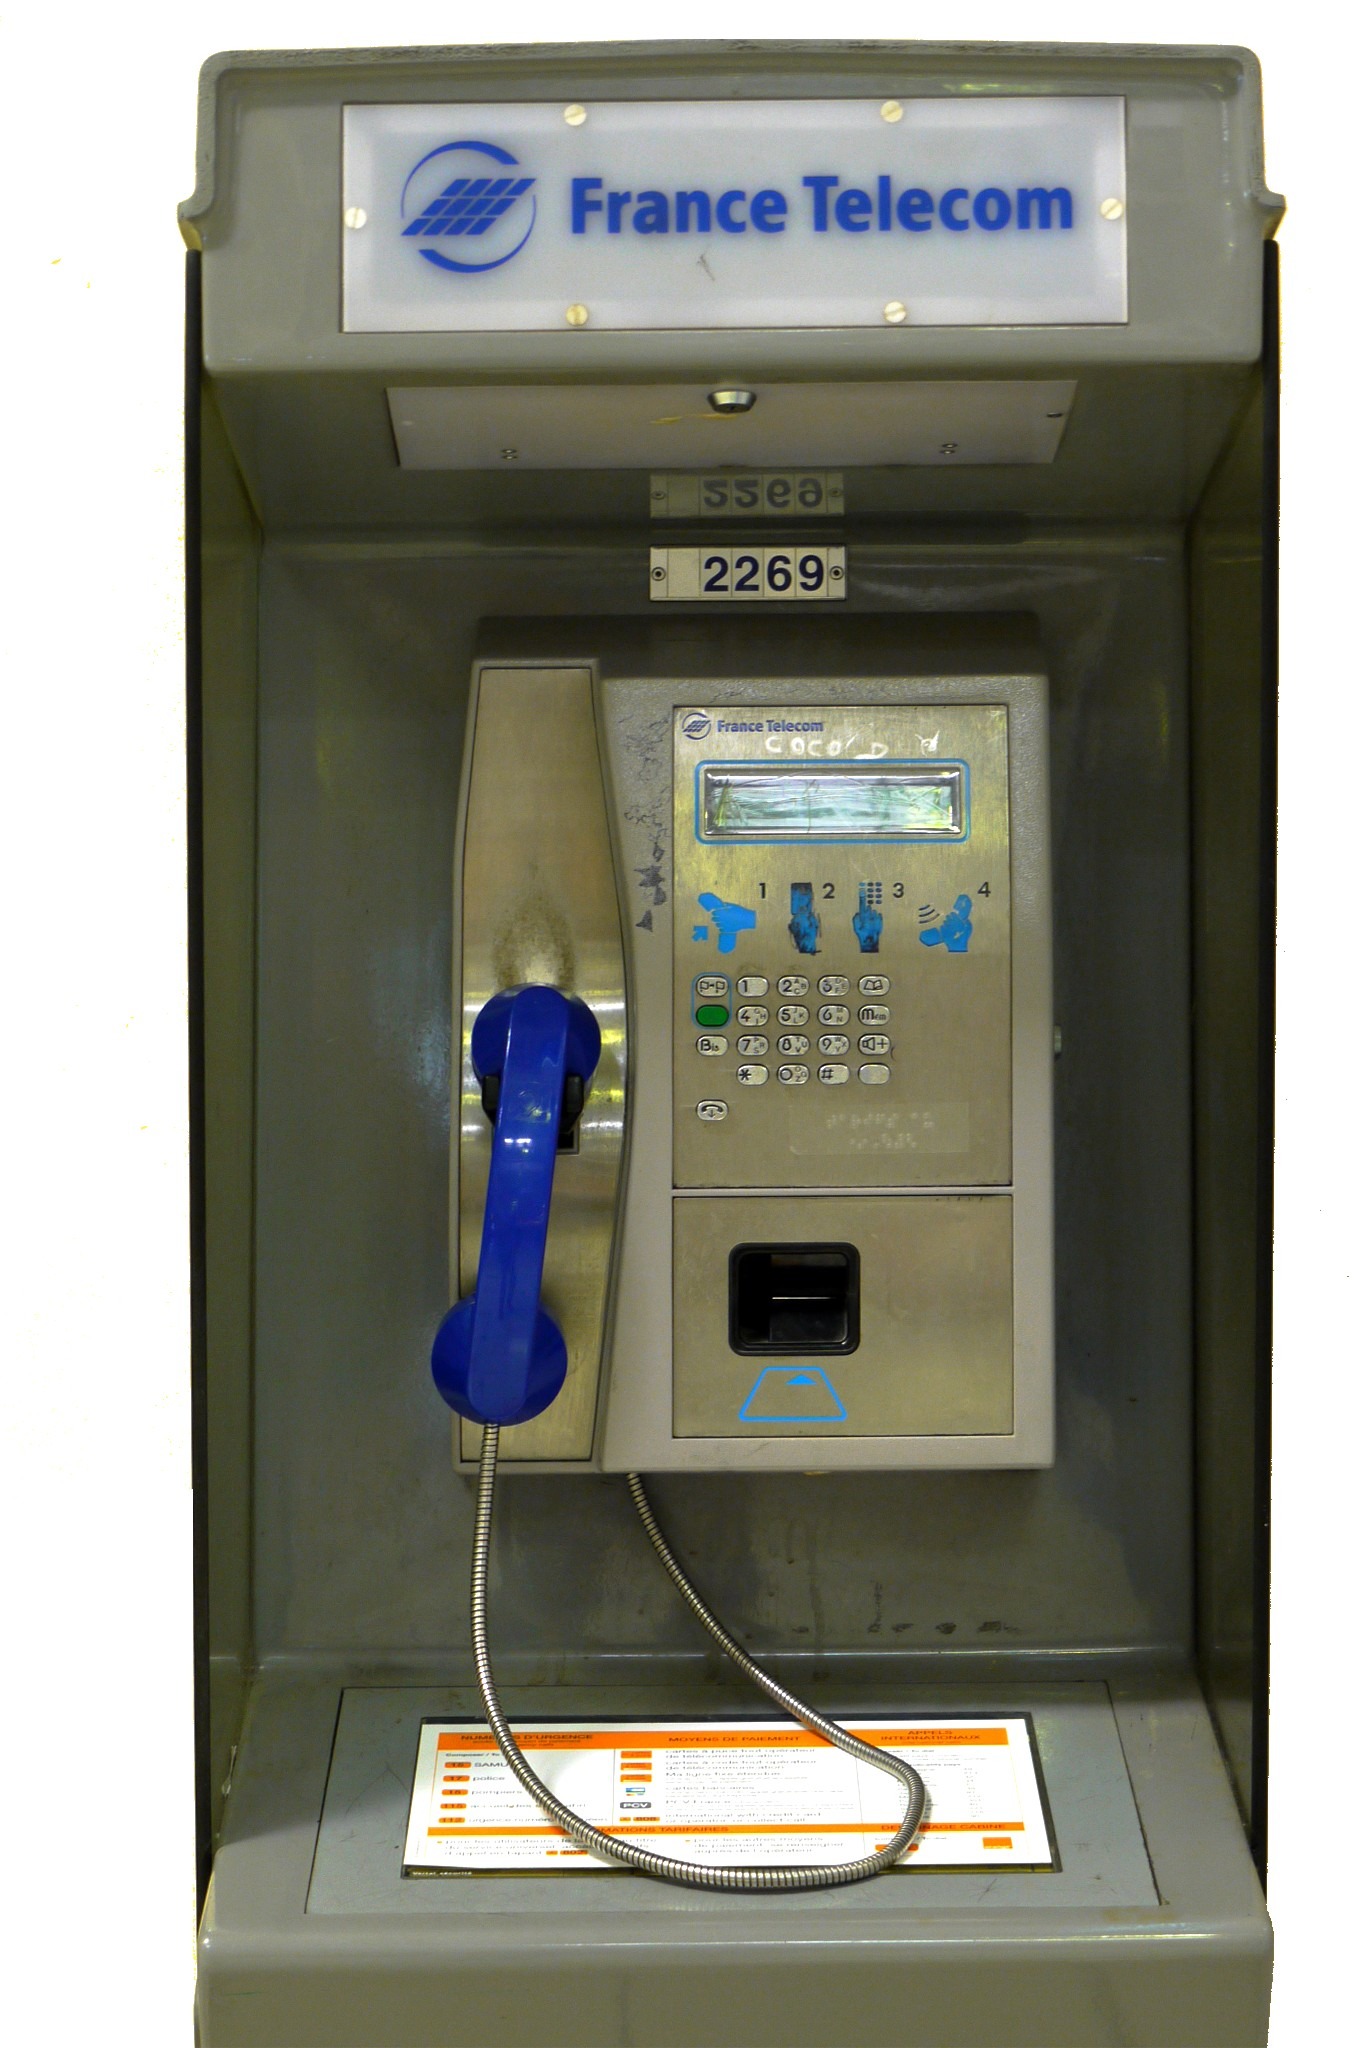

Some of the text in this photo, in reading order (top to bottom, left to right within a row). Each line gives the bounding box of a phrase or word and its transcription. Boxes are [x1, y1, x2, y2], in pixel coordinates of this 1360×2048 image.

[571, 175, 1073, 235] France Telecom
[703, 555, 824, 592] 2269
[717, 719, 824, 733] France Telecom
[759, 882, 766, 899] 1
[822, 882, 835, 899] 2
[892, 882, 905, 899] 3
[977, 881, 991, 898] 4
[742, 980, 748, 993] 1
[782, 980, 792, 993] 2
[822, 980, 832, 993] 3
[741, 1008, 751, 1023] 4
[781, 1009, 791, 1021] 5
[823, 1008, 832, 1021] 6
[700, 1039, 720, 1052] Bis
[742, 1039, 751, 1052] 7
[782, 1038, 791, 1051] 8
[822, 1038, 831, 1051] 9
[780, 1068, 792, 1081] 0
